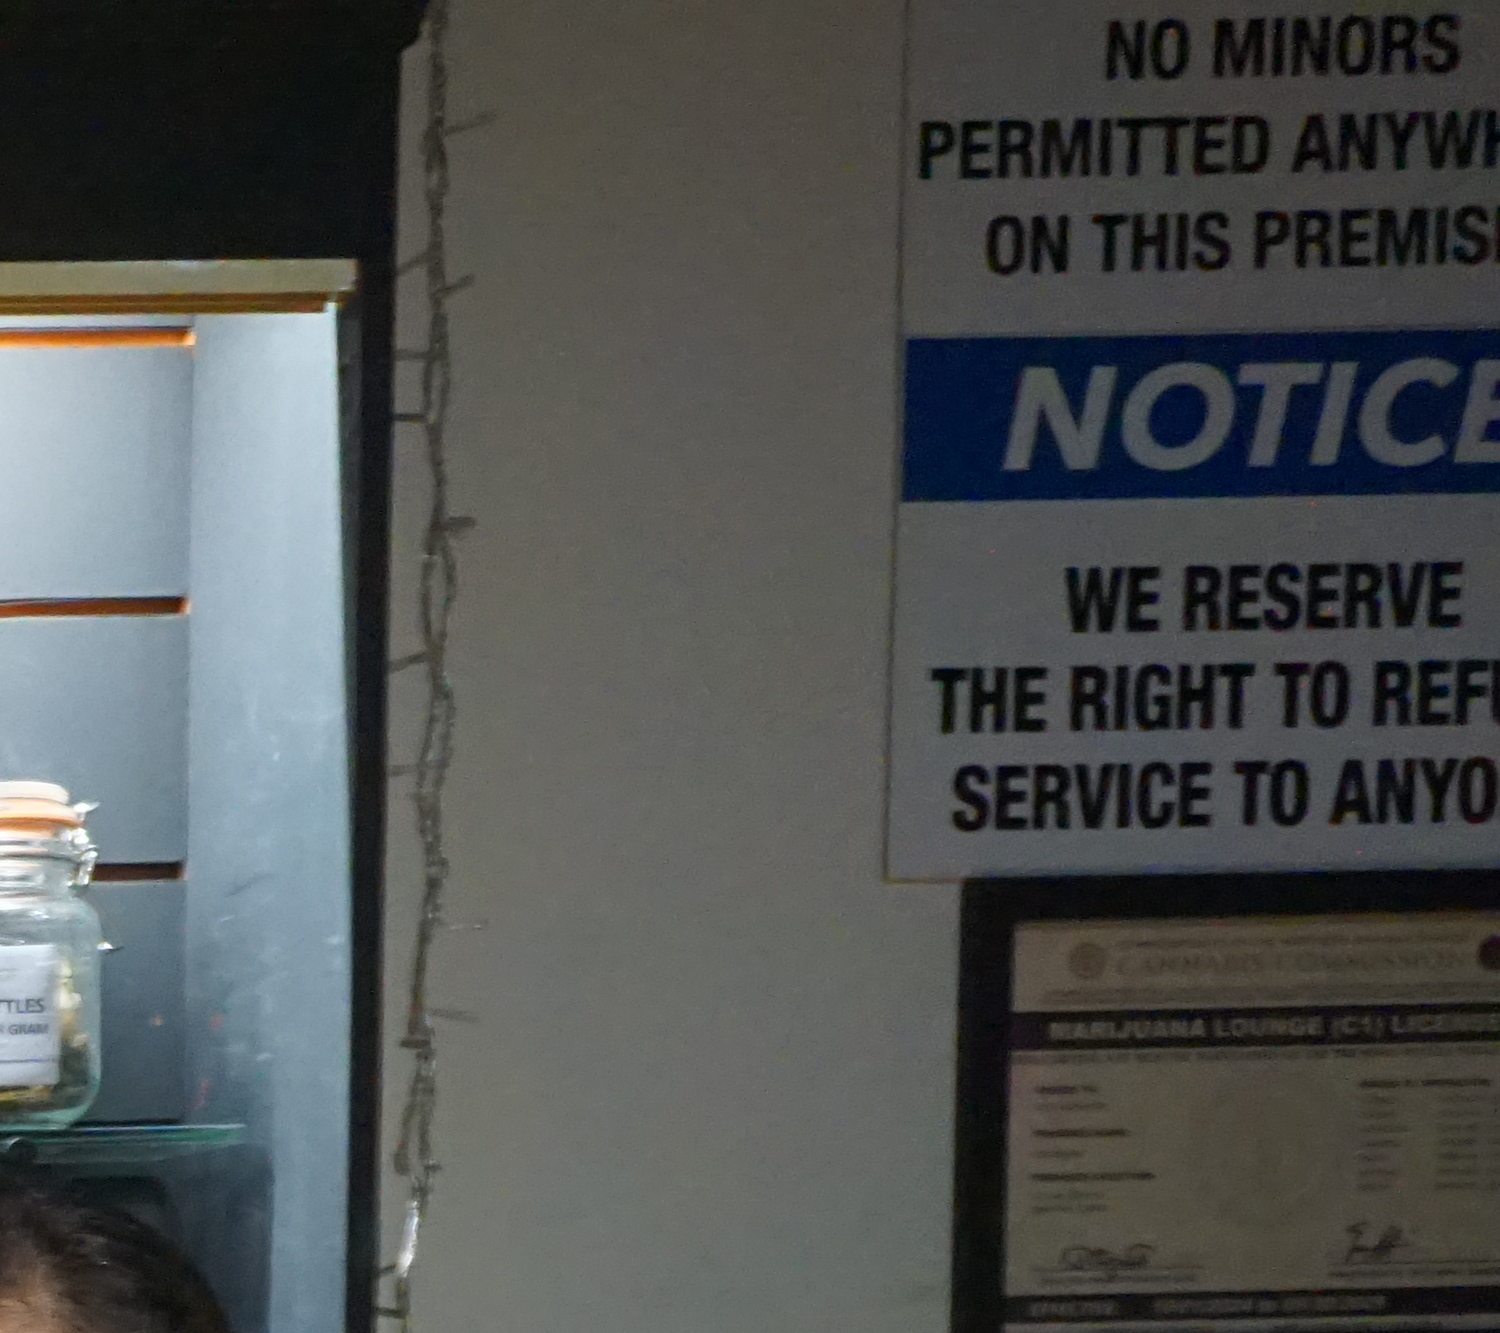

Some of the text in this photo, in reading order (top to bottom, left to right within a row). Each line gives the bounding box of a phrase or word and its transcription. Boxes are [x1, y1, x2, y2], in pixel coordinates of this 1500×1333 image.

[1105, 14, 1463, 80] NO MINORS
[917, 114, 1271, 179] PERMITTED
[985, 204, 1500, 275] ON THIS PREMIS
[1001, 356, 1500, 471] NOTICE
[1063, 560, 1464, 633] WE RESERVE
[931, 658, 1500, 735] THE RIGHT TO REF
[951, 757, 1498, 832] SERVICE TO ANYO
